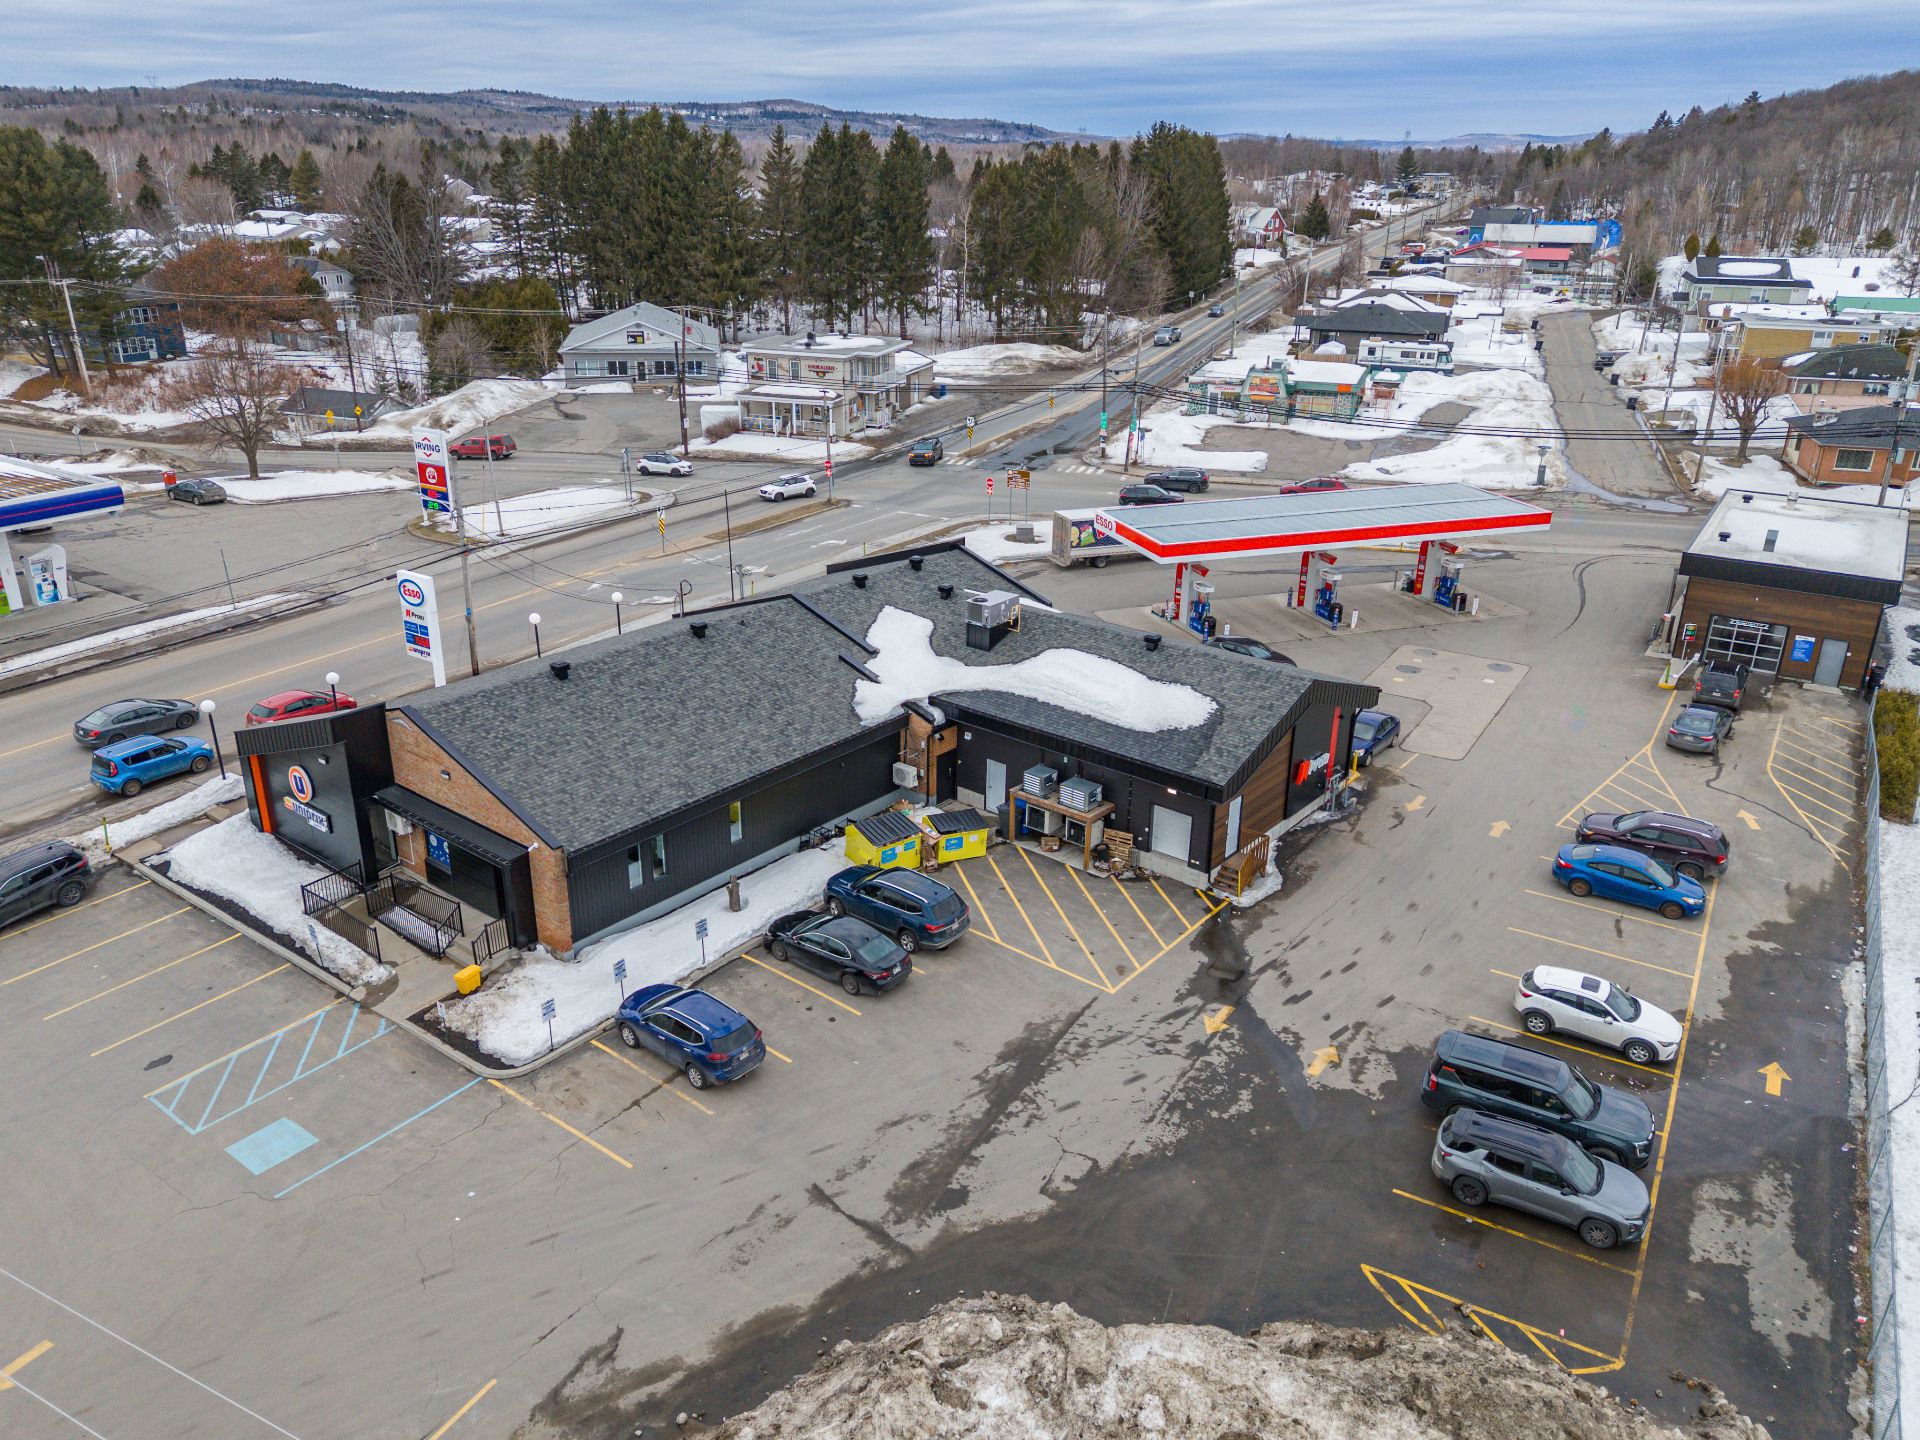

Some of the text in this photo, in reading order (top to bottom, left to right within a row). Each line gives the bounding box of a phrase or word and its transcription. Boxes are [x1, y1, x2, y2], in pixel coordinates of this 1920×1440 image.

[415, 441, 441, 453] IRVING
[1095, 514, 1113, 531] ESSO
[292, 802, 325, 826] uniprix
